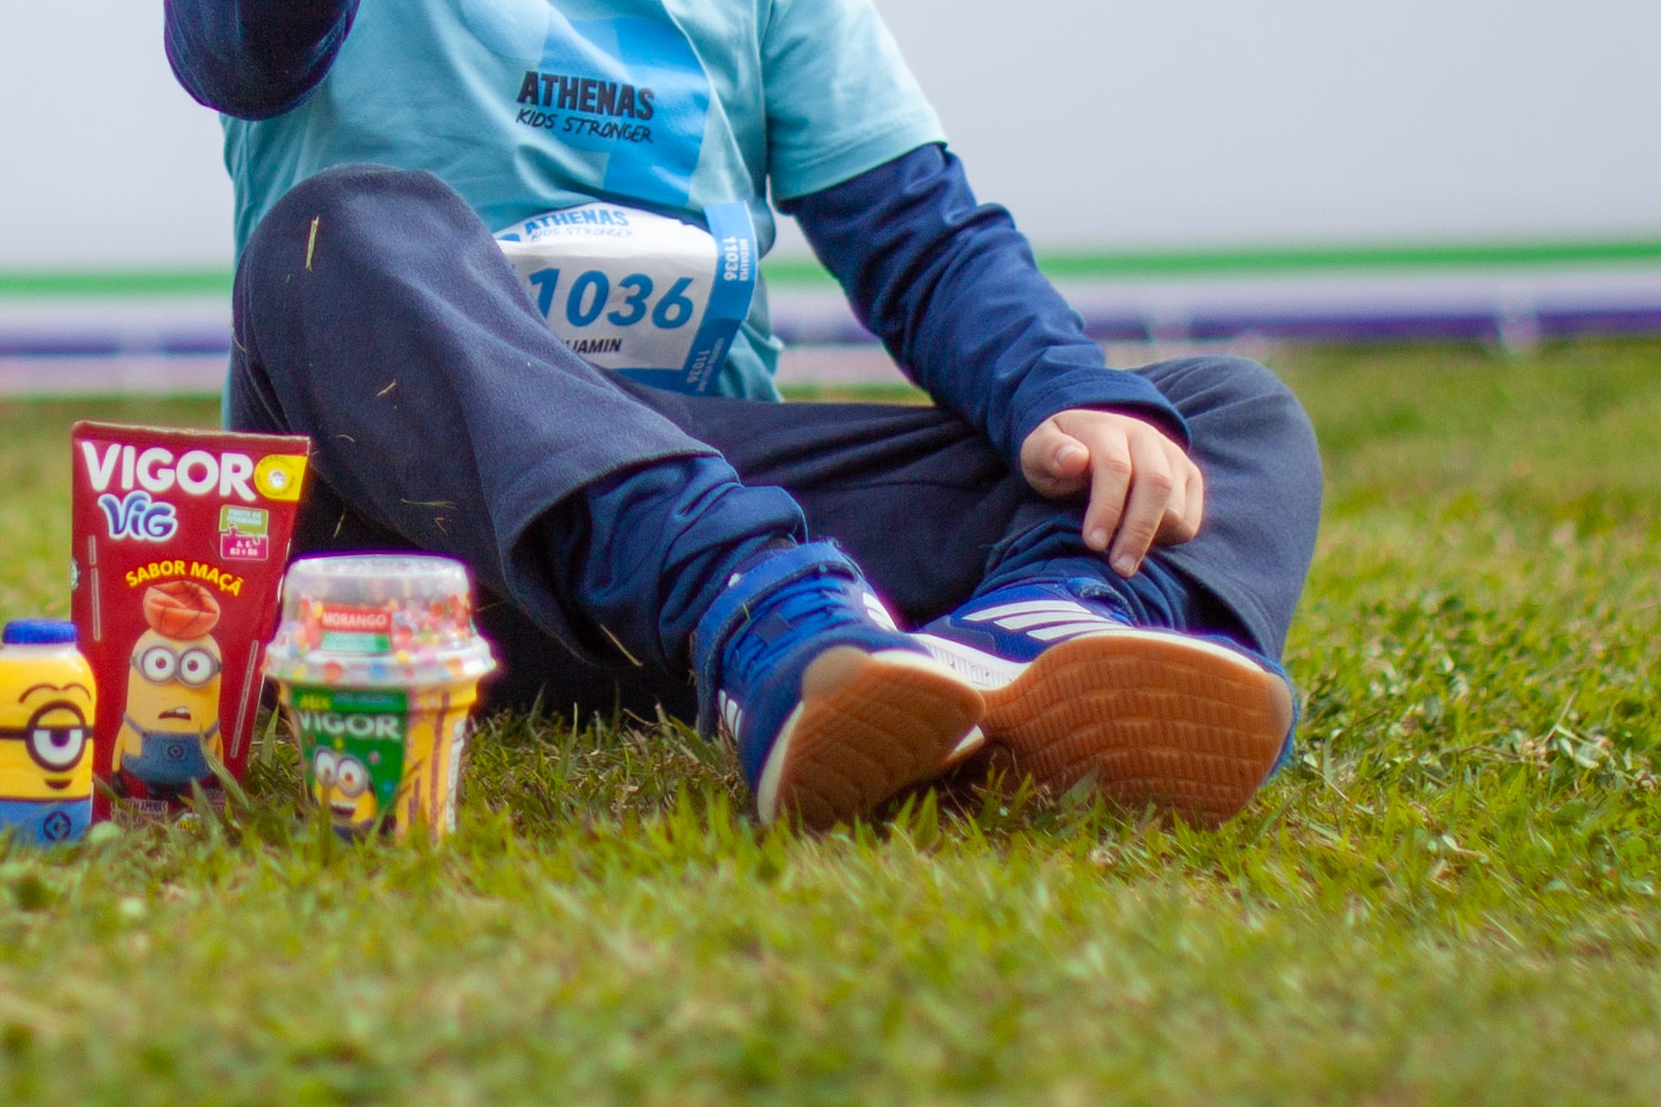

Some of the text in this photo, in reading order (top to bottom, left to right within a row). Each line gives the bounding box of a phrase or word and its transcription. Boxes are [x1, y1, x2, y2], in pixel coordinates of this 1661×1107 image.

[517, 70, 655, 121] ATHENAS
[516, 108, 654, 144] KIDS STRONGER
[525, 209, 629, 235] ATHENAS
[723, 236, 739, 282] 11036
[528, 267, 695, 330] 1036
[566, 338, 623, 353] JAMIN
[82, 441, 257, 502] VIGOR
[125, 560, 245, 597] SABOR MAÇÃ
[322, 612, 387, 626] MORANGO
[299, 712, 402, 740] VIGOR
